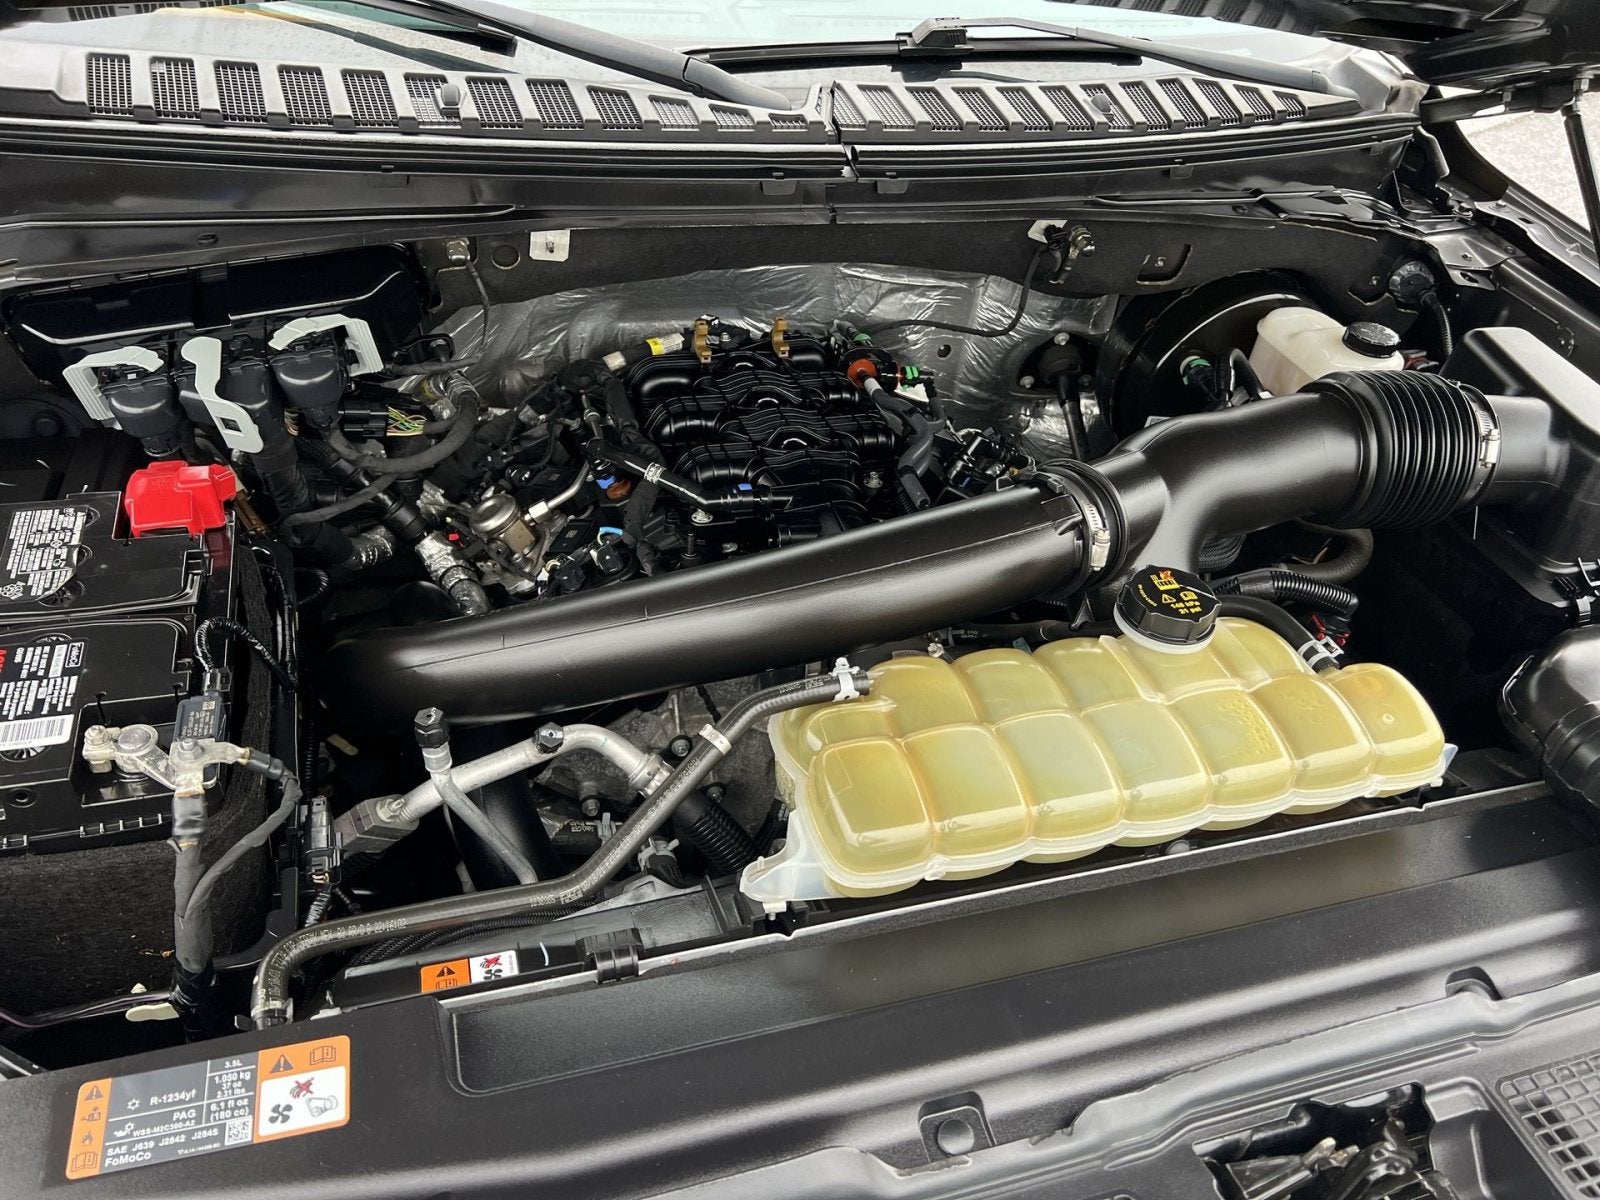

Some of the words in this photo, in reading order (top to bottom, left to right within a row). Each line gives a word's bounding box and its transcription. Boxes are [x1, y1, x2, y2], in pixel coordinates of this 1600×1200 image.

[224, 1059, 243, 1069] 3.5L
[214, 1072, 238, 1085] 1.050
[239, 1071, 251, 1080] kg
[221, 1082, 231, 1090] 37
[150, 1089, 196, 1106] R-1234yf
[210, 1101, 225, 1111] 6.1
[236, 1098, 249, 1107] oz
[172, 1109, 196, 1121] PAG
[210, 1109, 232, 1122] (180
[232, 1106, 249, 1117] cc)
[107, 1145, 128, 1156] SAE
[132, 1140, 155, 1152] J639
[158, 1134, 186, 1147] J2842
[191, 1128, 219, 1140] J2845
[104, 1152, 152, 1168] FoMoCo
